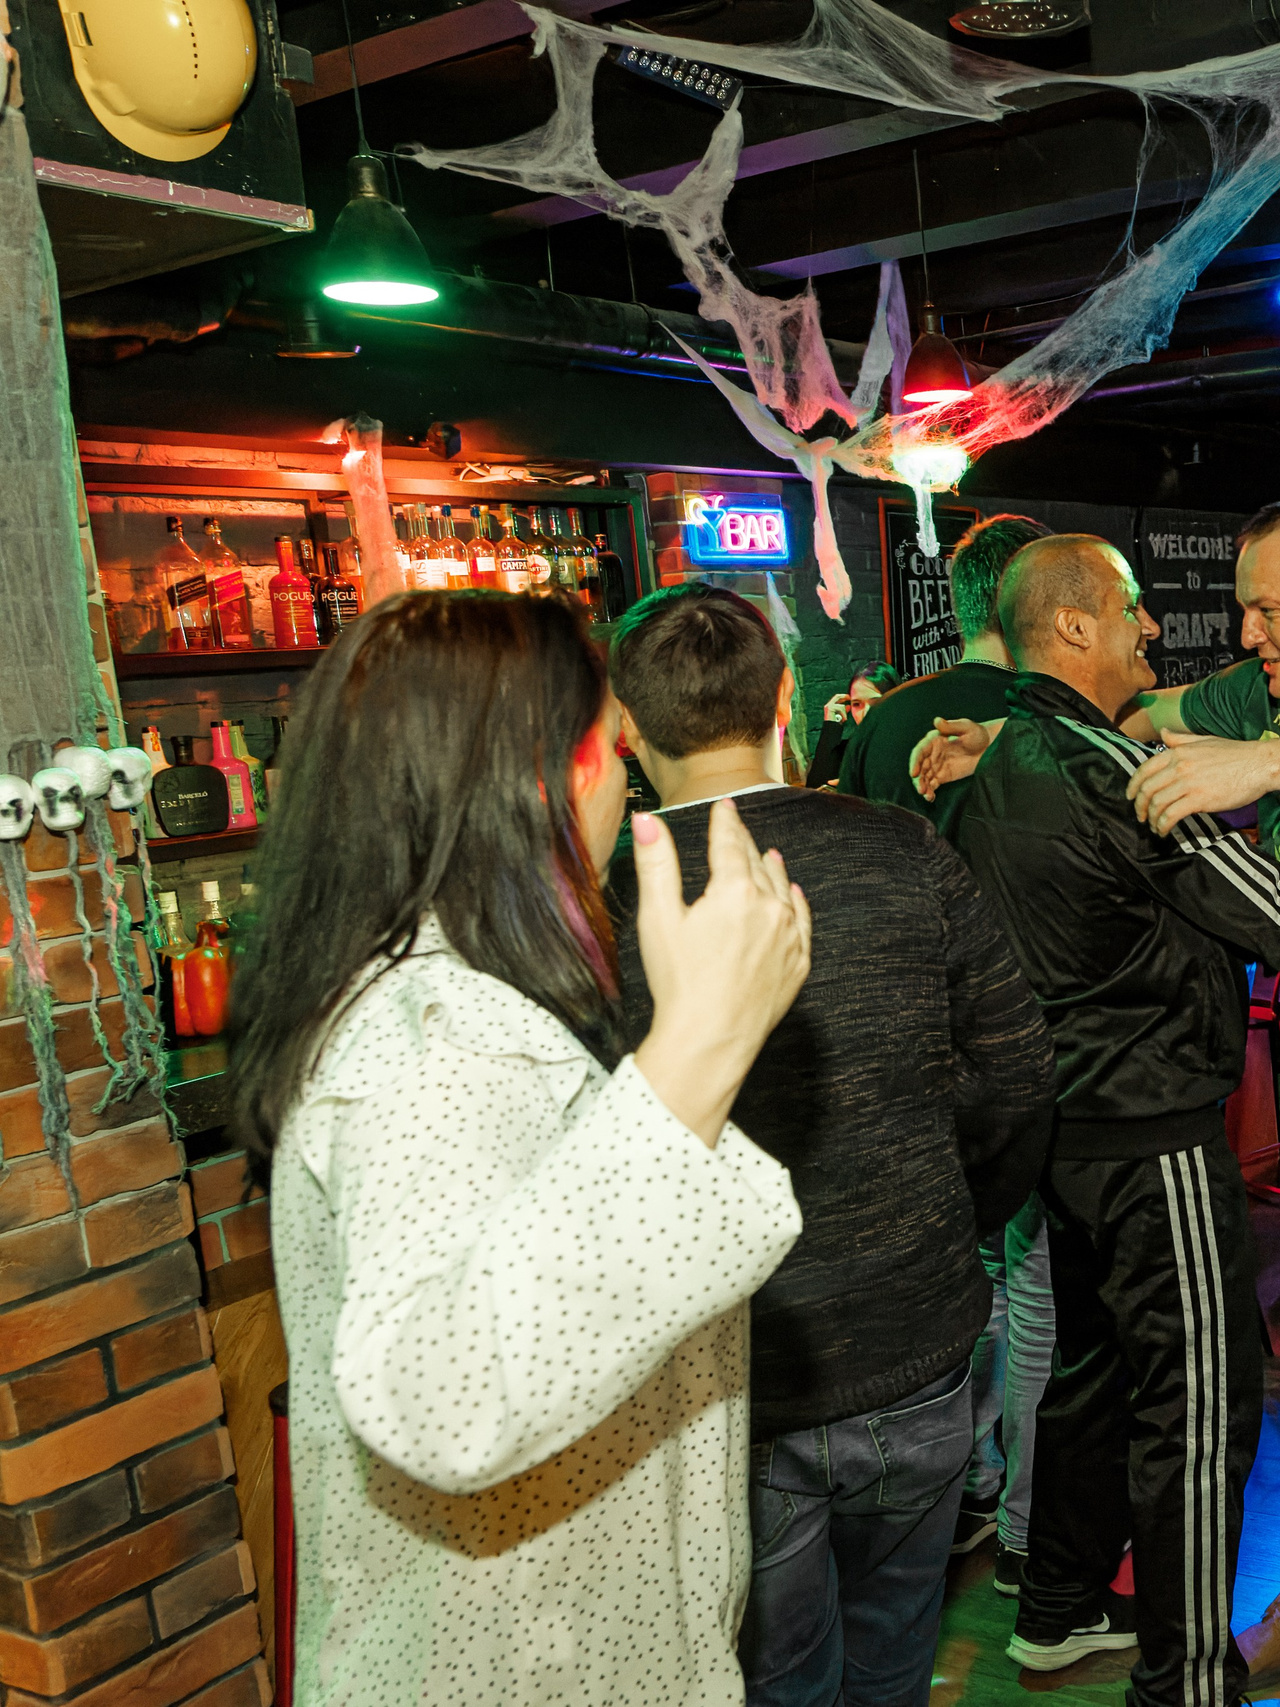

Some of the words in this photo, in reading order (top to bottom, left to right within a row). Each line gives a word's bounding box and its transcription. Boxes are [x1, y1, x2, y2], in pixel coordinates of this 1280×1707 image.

[725, 513, 782, 551] BAR
[1148, 532, 1233, 560] WELCOME
[1186, 570, 1201, 590] to
[908, 579, 954, 630] BEE
[912, 625, 942, 651] with
[1162, 612, 1230, 649] CRAFT
